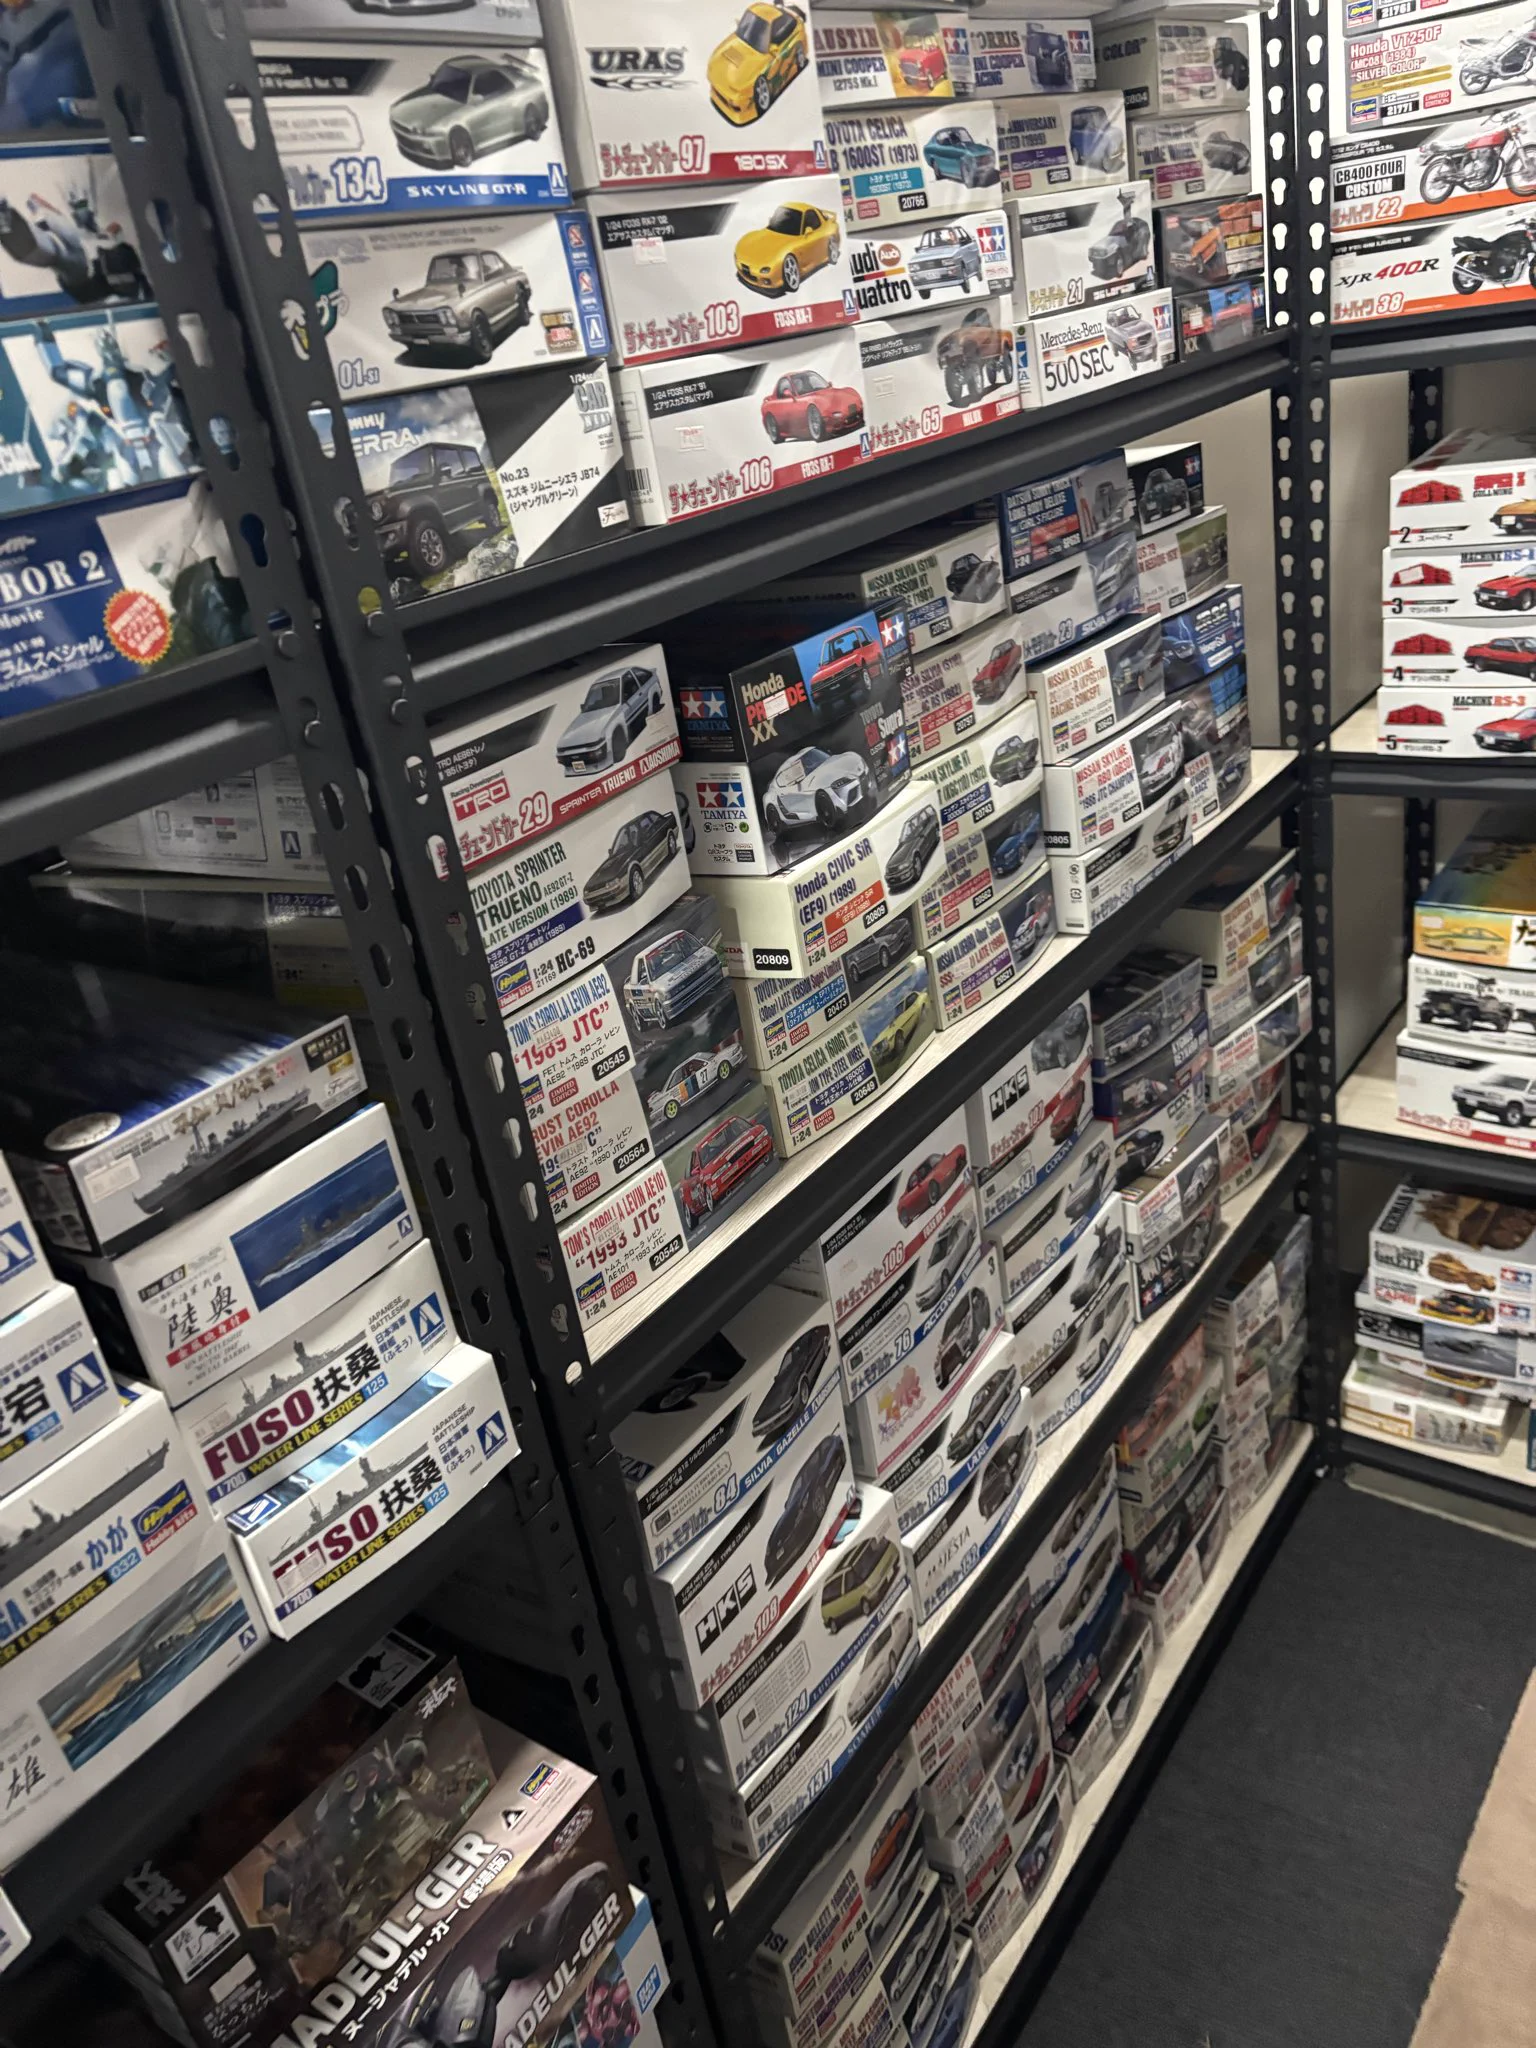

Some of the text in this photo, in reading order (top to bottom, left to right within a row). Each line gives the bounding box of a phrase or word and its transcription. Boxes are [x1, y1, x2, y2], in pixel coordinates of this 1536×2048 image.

[814, 27, 880, 50] AUSTIN
[971, 30, 1021, 49] ORRIS
[1351, 25, 1442, 58] Honda VT250F
[585, 46, 688, 75] URAS
[817, 57, 887, 77] MINI COOPER
[1385, 48, 1416, 64] (1984)
[1387, 101, 1413, 115] 21771
[868, 115, 908, 141] CELICA
[679, 135, 706, 172] 97
[843, 143, 919, 171] 1600ST (1973)
[331, 156, 387, 202] 134
[1335, 160, 1403, 185] CB400 FOUR
[1345, 178, 1393, 199] CUSTOM
[406, 183, 489, 198] SKYLINE
[901, 195, 925, 209] 20766
[1376, 196, 1402, 220] 22
[1067, 277, 1085, 305] 21
[1376, 292, 1404, 315] 38
[704, 301, 741, 338] 103
[1040, 322, 1104, 350] Mercedes-Benz
[1044, 345, 1116, 392] 500 SEC
[574, 381, 610, 413] CAR
[920, 405, 942, 437] 65
[501, 468, 530, 483] No.23
[506, 485, 528, 500] スズキ
[580, 467, 600, 482] JB74
[740, 456, 773, 494] 106
[1400, 526, 1411, 543] 2
[79, 551, 107, 583] 2
[1391, 597, 1403, 614] 3
[1058, 617, 1075, 645] 23
[741, 673, 785, 706] Honda
[1391, 666, 1404, 682] 4
[750, 718, 780, 747] XX
[877, 709, 904, 740] Supra
[1386, 734, 1398, 750] 5
[1076, 743, 1128, 784] NISSAN SKYLINE
[453, 779, 510, 820] TRD
[559, 766, 637, 815] SPRINTER TRUENO
[519, 791, 550, 834] 29
[700, 809, 748, 821] TAMIYA
[470, 840, 568, 907] TOYOTA SPRINTER
[794, 837, 874, 904] Honda CIVIC SiR
[476, 881, 544, 930] TRUENO
[482, 884, 579, 949] LATE VERSION (1989)
[799, 877, 858, 927] (EF9) (1989)
[865, 906, 886, 925] 20809
[532, 960, 555, 981] 1:24
[557, 936, 596, 974] HC-69
[755, 954, 790, 967] 20809
[807, 950, 828, 968] 1:24
[509, 972, 611, 1049] TOM'S LEVIN AE92
[827, 996, 849, 1018] 20473
[542, 1025, 621, 1078] FET カローラ レビン
[595, 1050, 627, 1077] 20545
[778, 1031, 850, 1094] TOYOTA CELICA 1600GT
[853, 1080, 877, 1102] 20649
[990, 1065, 1030, 1119] HKS
[568, 1112, 600, 1143] AE92
[591, 1138, 616, 1159] カローラ
[616, 1126, 634, 1142] レビン
[617, 1144, 647, 1170] 20564
[563, 1168, 668, 1259] TOM'S LEVIN AE101
[623, 1227, 663, 1267] カローラ レビン
[652, 1240, 681, 1266] 20542
[882, 1240, 905, 1278] 106
[167, 1284, 238, 1350] 陸奥
[368, 1295, 405, 1326] JAPANESE
[370, 1298, 412, 1333] BATTLESHIP
[585, 1299, 608, 1320] 1:24
[922, 1286, 957, 1336] ACCORD
[375, 1316, 408, 1344] 日本海軍
[893, 1327, 913, 1362] 76
[383, 1336, 414, 1364] (ふそう)
[313, 1343, 381, 1410] 扶桑
[203, 1387, 315, 1481] FUSO
[249, 1374, 388, 1476] WATER LINE SERIES 125
[431, 1403, 467, 1436] JAPANESE
[433, 1405, 476, 1442] BATTLESHIP
[446, 1444, 476, 1475] (ふそう)
[714, 1411, 811, 1515] 84 SILVIA GAZELLE
[378, 1455, 443, 1524] 扶桑
[927, 1474, 949, 1509] 138
[85, 1515, 130, 1571] かが
[315, 1484, 449, 1592] WATER LINE SERIES 125
[110, 1551, 140, 1580] 032
[55, 1574, 108, 1624] SERIES
[694, 1564, 757, 1654] HKS
[755, 1595, 780, 1642] 108
[806, 1759, 833, 1801] 131
[270, 1831, 498, 2048] ADEUL-GER
